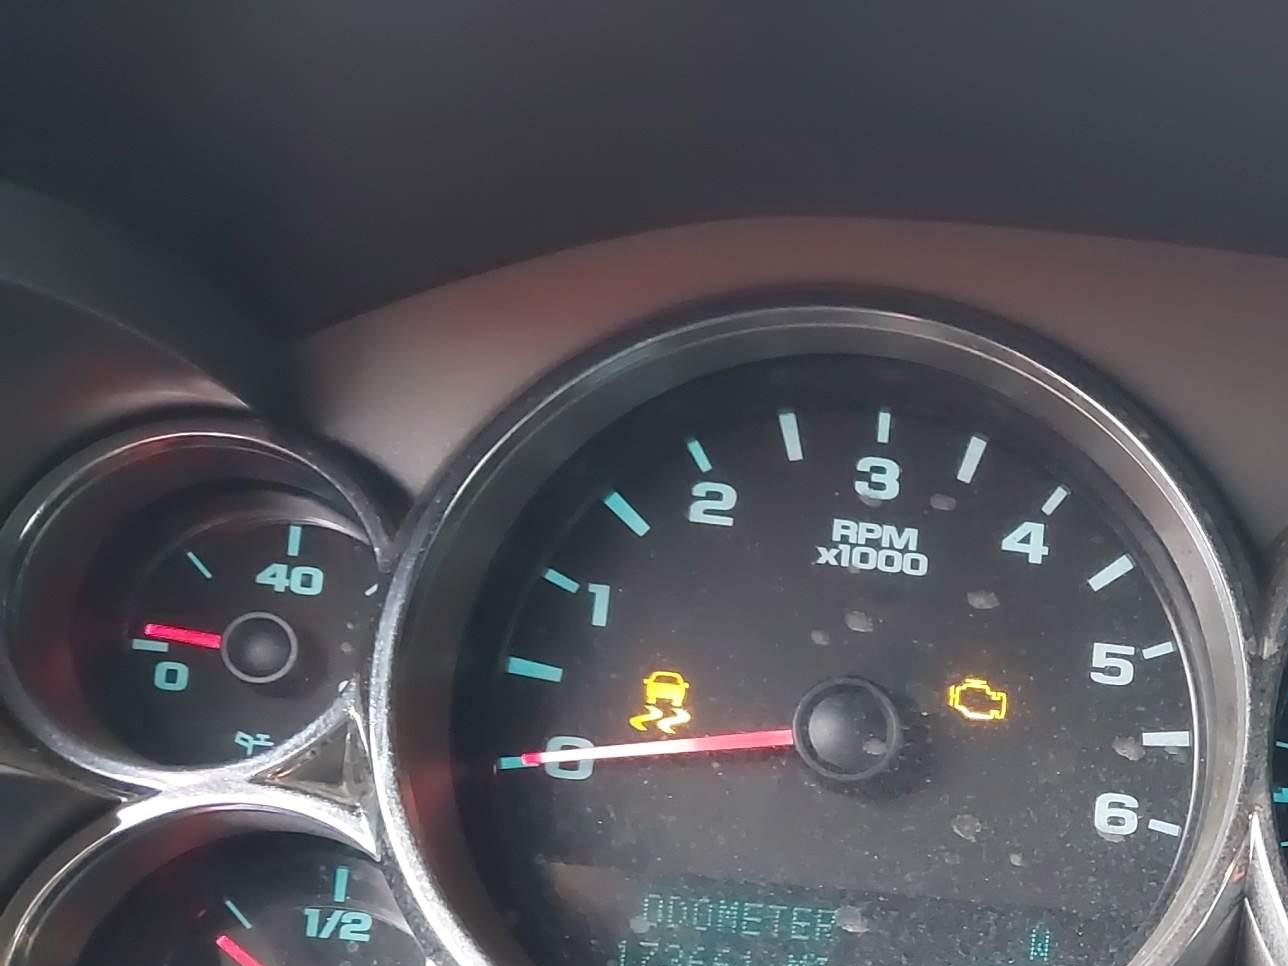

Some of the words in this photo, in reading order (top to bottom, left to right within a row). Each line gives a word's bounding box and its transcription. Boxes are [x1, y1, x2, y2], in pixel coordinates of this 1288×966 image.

[855, 456, 900, 501] 3
[688, 481, 738, 527] 2
[830, 518, 919, 552] RPM
[1001, 521, 1049, 564] 4
[255, 564, 324, 596] 40
[816, 545, 928, 577] x1000
[587, 583, 611, 627] 1
[154, 661, 190, 692] 0
[1090, 642, 1135, 685] 5
[1093, 792, 1139, 837] 6
[304, 907, 373, 942] 1/2
[641, 893, 837, 941] ODOMETER
[1029, 928, 1050, 960] N
